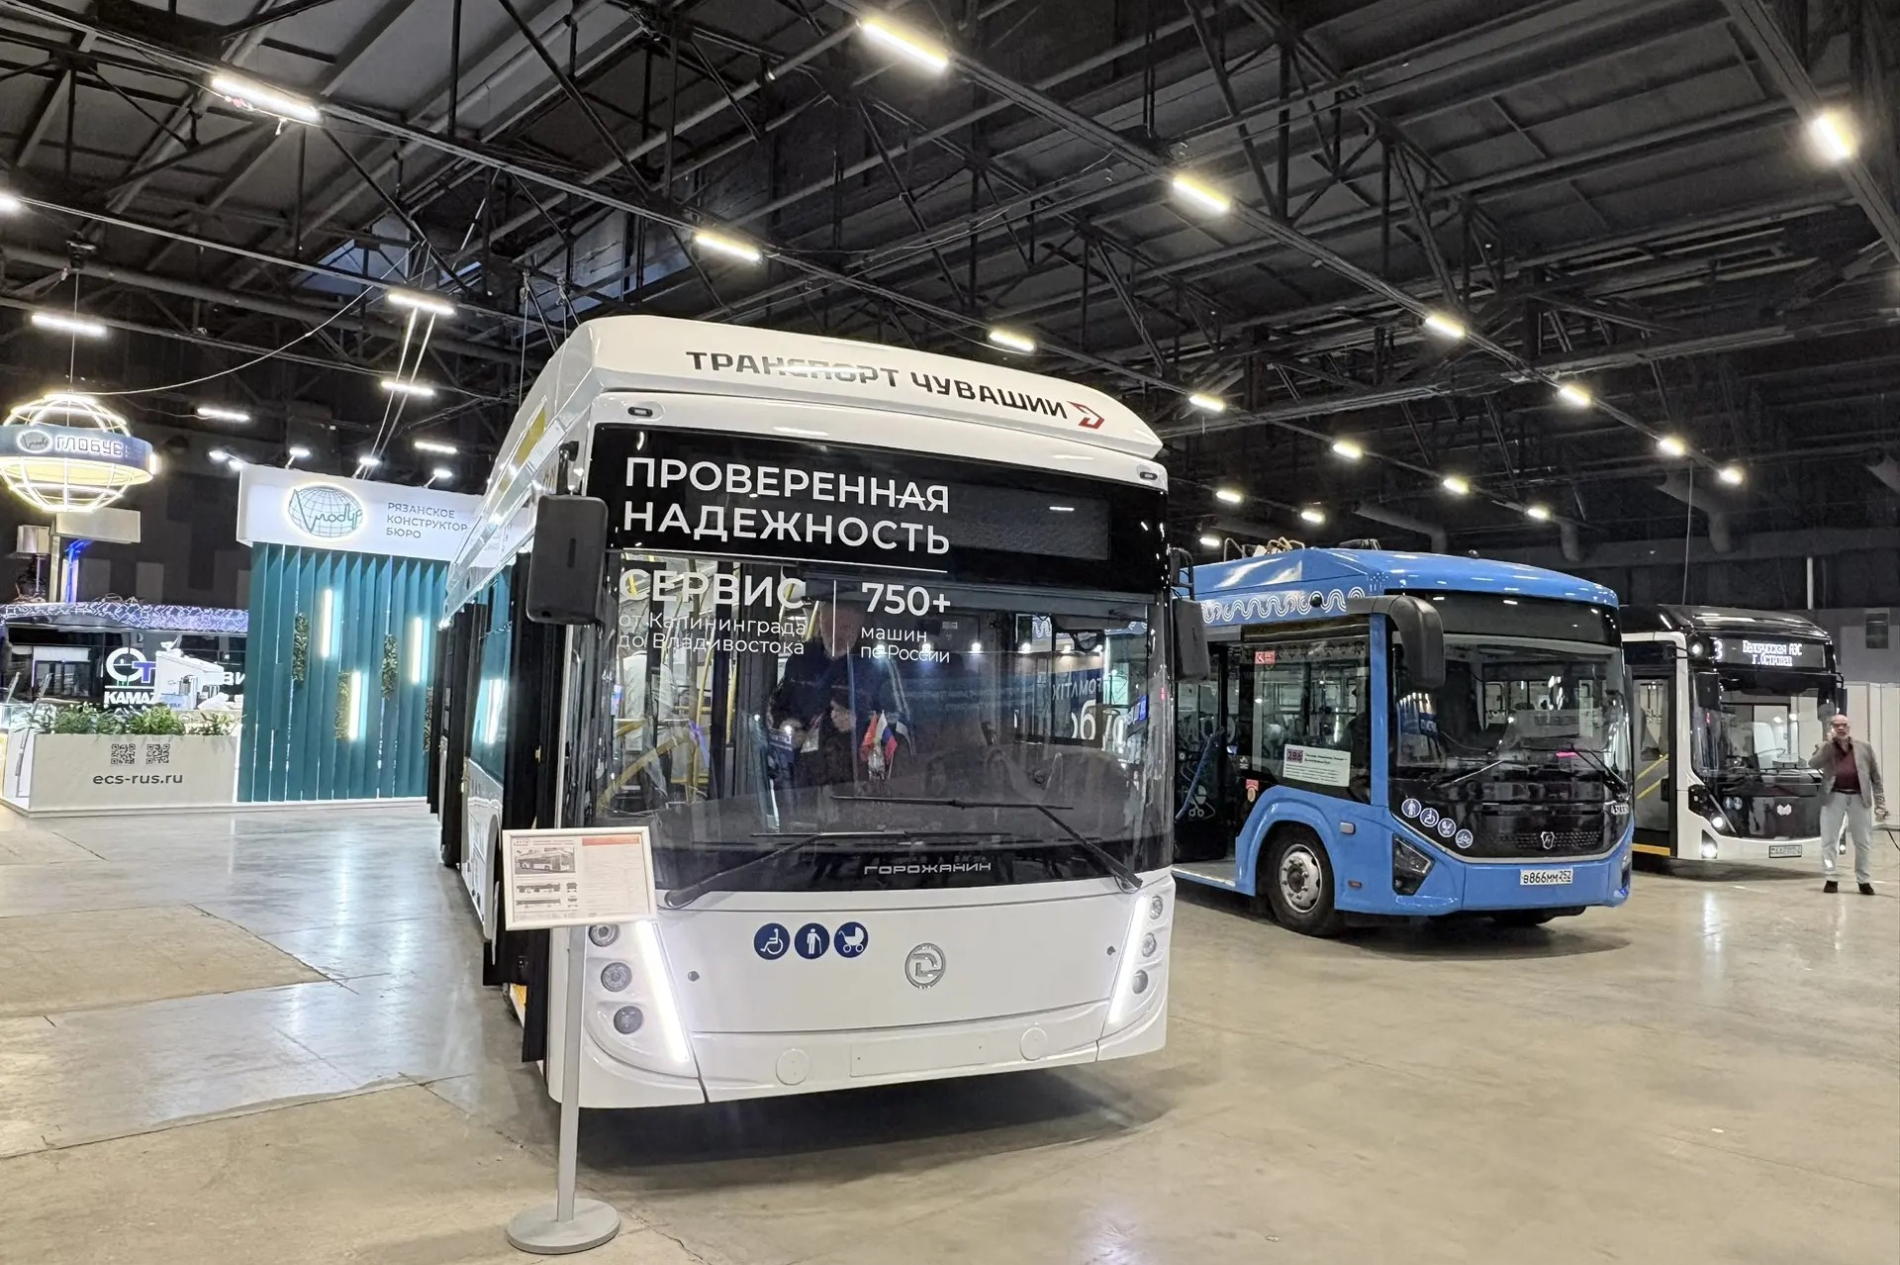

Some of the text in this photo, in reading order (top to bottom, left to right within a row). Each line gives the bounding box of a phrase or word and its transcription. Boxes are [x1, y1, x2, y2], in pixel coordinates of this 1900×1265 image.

[686, 351, 1068, 420] ТРАНСПОРТ ЧУВАШИИ
[625, 456, 949, 513] ПРОВЕРЕННАЯ
[387, 502, 455, 519] РЯЗАНСКОЕ
[386, 515, 468, 532] КОНСТРУКТОР
[386, 527, 422, 539] БЮРО
[623, 501, 950, 555] НАДЕЖНОСТЬ
[618, 568, 807, 609] СЕРВИС
[861, 581, 951, 616] 750+
[649, 611, 807, 637] Калининграда
[618, 632, 805, 655] до Владивостока
[861, 626, 928, 643] машин
[861, 645, 950, 663] по России
[92, 774, 183, 785] ecs-rus.ru
[864, 863, 992, 875] ГОРОЖАНИН
